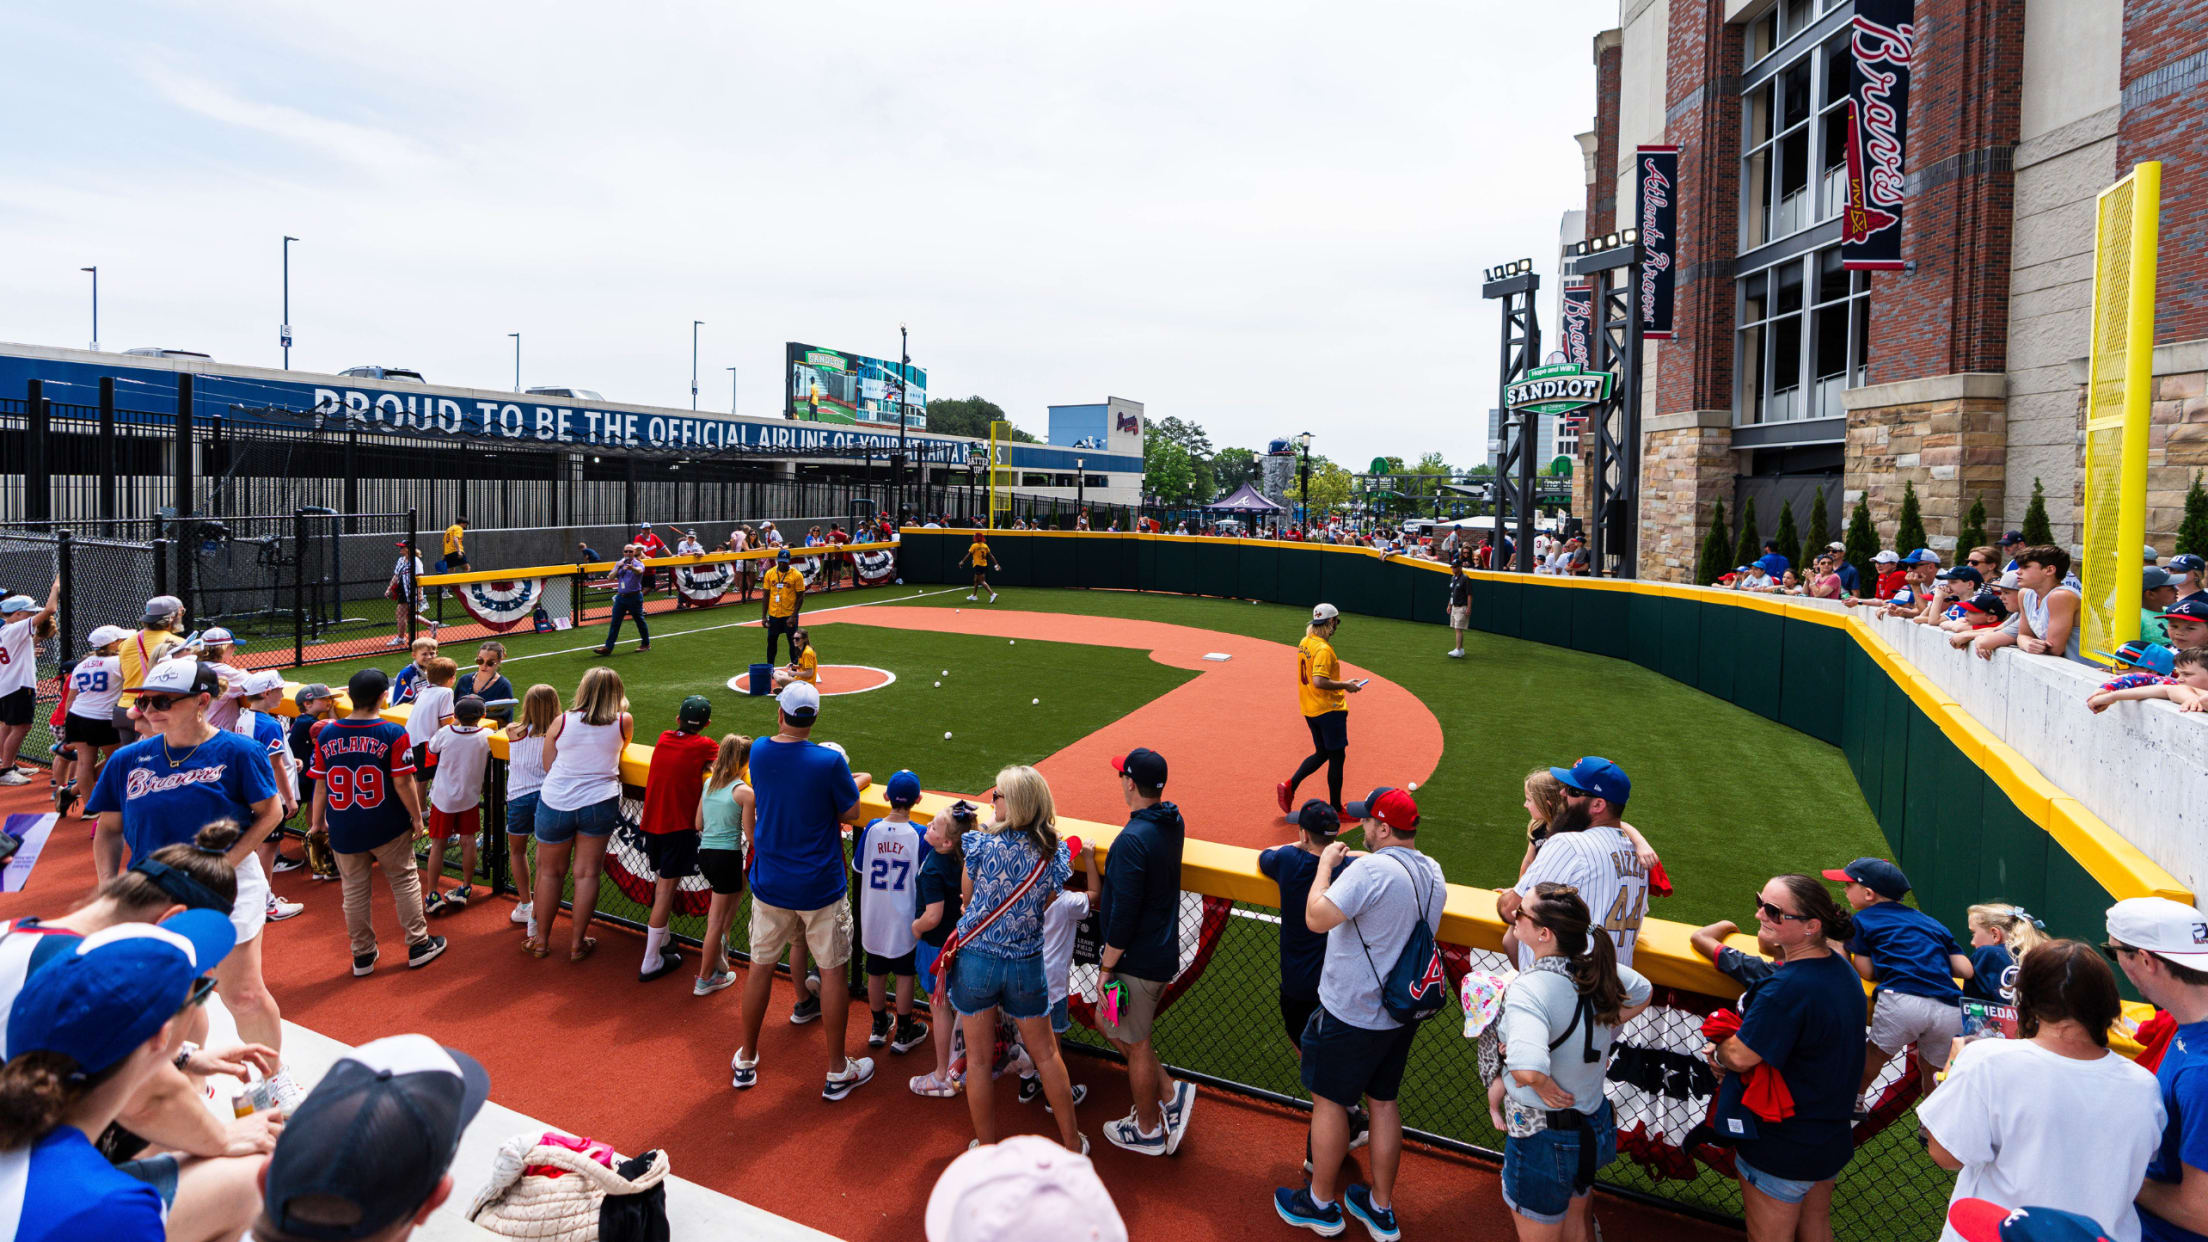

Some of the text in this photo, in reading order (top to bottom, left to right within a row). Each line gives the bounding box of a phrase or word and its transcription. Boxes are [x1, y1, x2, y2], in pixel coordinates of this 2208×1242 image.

[1852, 14, 1913, 206] Braves
[1641, 158, 1670, 323] Atlanta Braves
[1563, 298, 1592, 371] Brave
[1531, 367, 1547, 377] Hope
[1547, 365, 1559, 374] and
[1507, 379, 1597, 405] SANDLOT
[314, 388, 463, 434] PROUD
[476, 401, 524, 438] TO
[536, 407, 574, 441] BE
[584, 411, 639, 446] THE
[648, 416, 752, 451] OFFICIAL
[758, 425, 828, 452] AIRLINE
[833, 431, 855, 455] OF
[860, 434, 900, 459] YOUR
[904, 437, 960, 463] ATLANTA
[1536, 540, 1542, 549] 3
[76, 672, 109, 693] 28
[320, 735, 389, 760] ATLANTA
[126, 763, 228, 801] Braves
[327, 765, 386, 811] 99
[877, 841, 905, 855] RILEY
[870, 857, 912, 893] 27
[1603, 884, 1647, 948] 44
[1077, 937, 1095, 947] LEAVE
[1123, 1130, 1135, 1142] N
